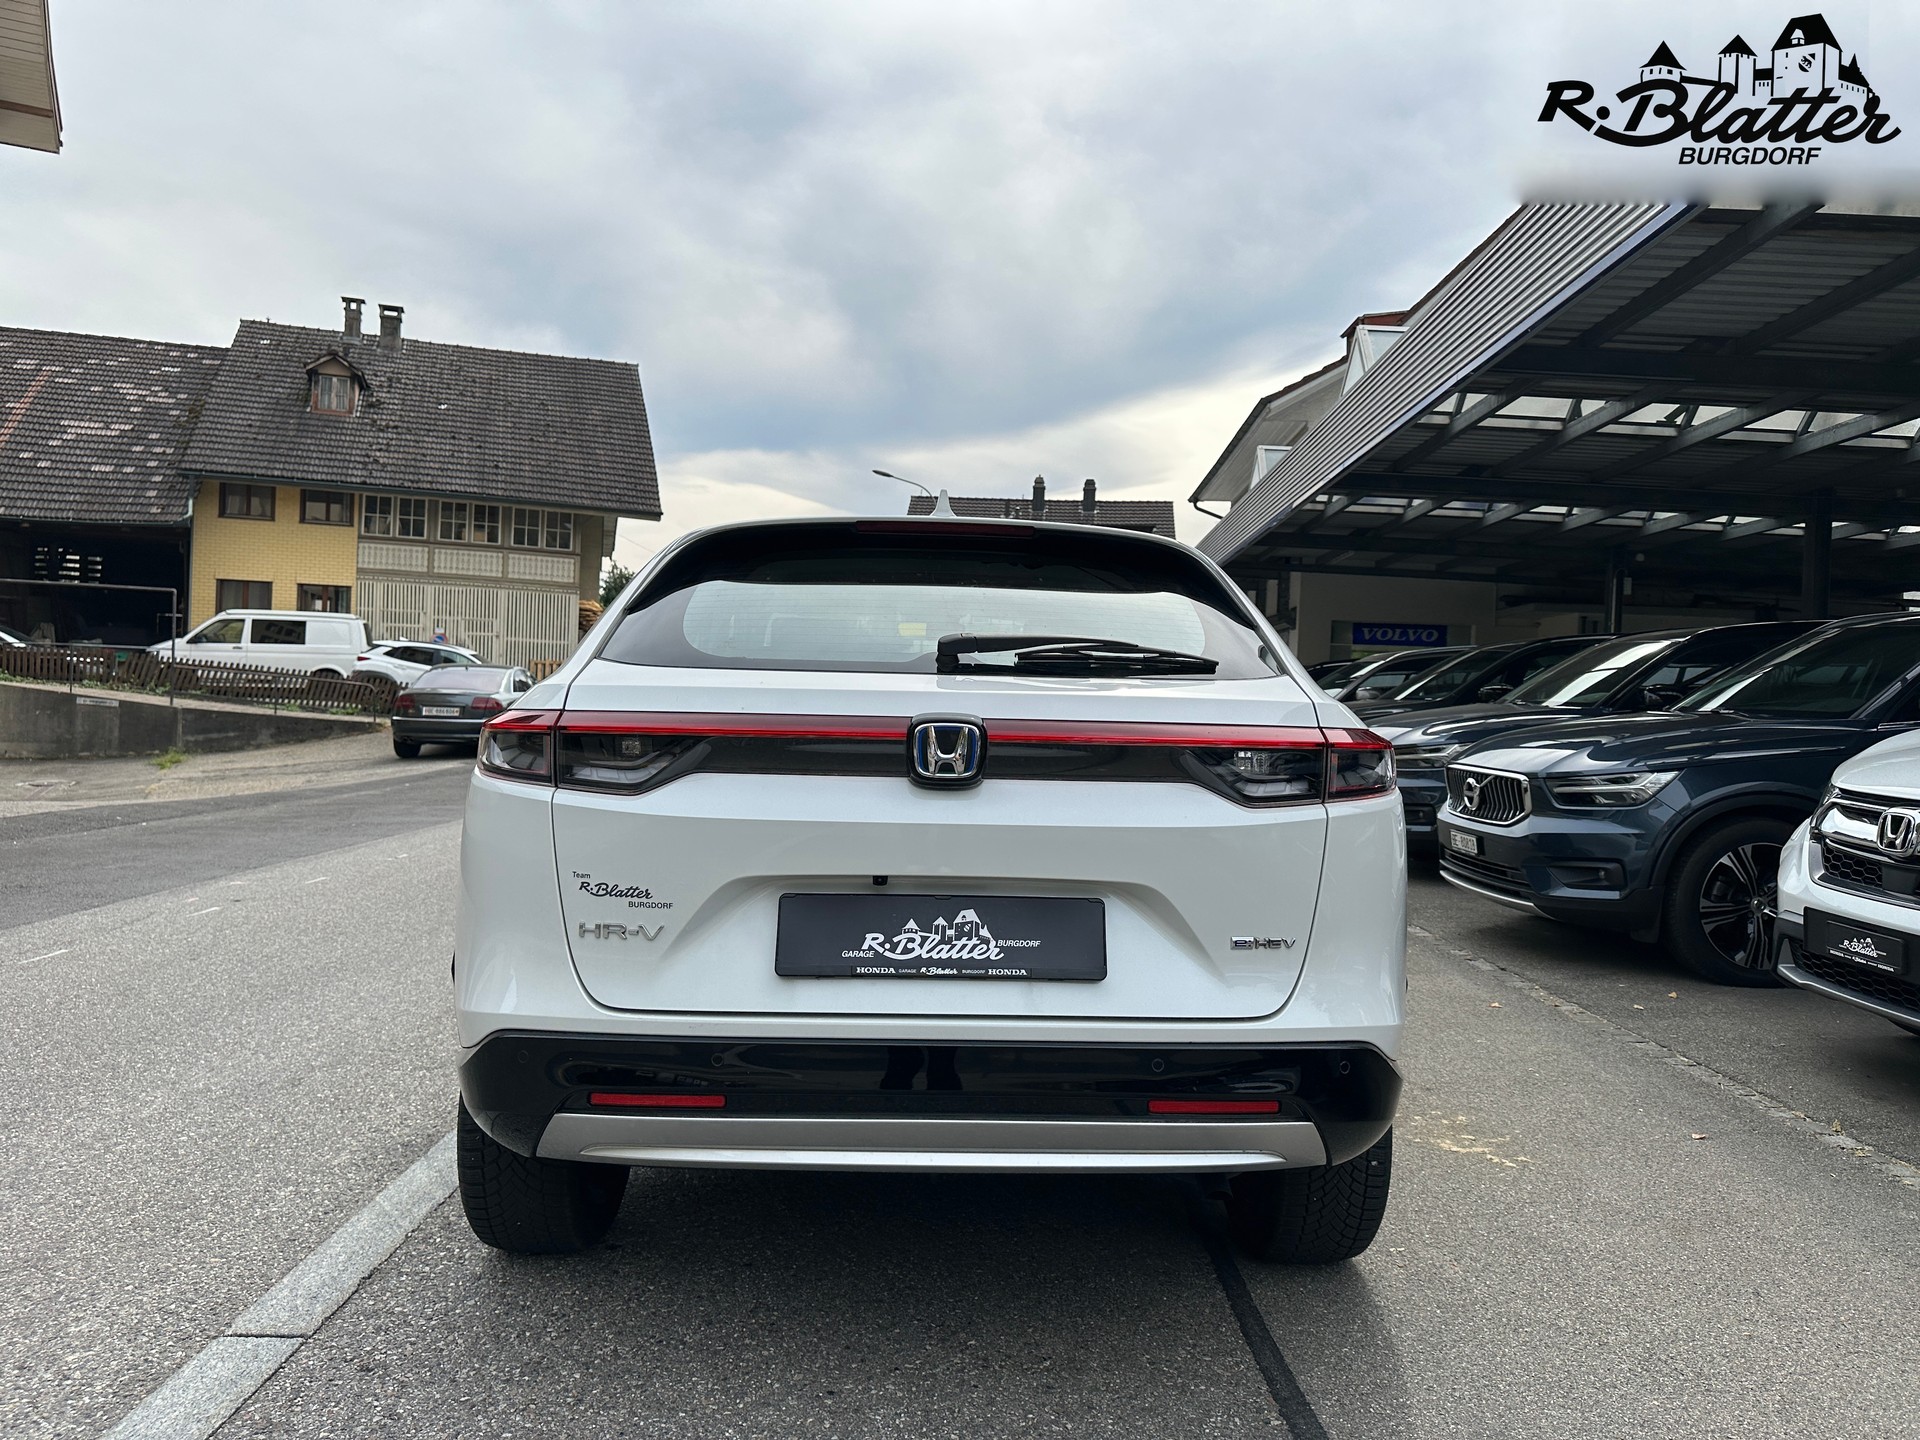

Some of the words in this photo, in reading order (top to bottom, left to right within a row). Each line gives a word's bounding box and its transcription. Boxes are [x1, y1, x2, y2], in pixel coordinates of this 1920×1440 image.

[1361, 627, 1440, 643] VOLVO
[572, 871, 591, 879] Team
[628, 901, 674, 909] BURGDORF
[578, 921, 665, 942] HR-V
[841, 950, 876, 958] GARAGE
[997, 939, 1042, 948] BURGDORF
[856, 966, 896, 975] HONDA
[988, 968, 1028, 976] HONDA
